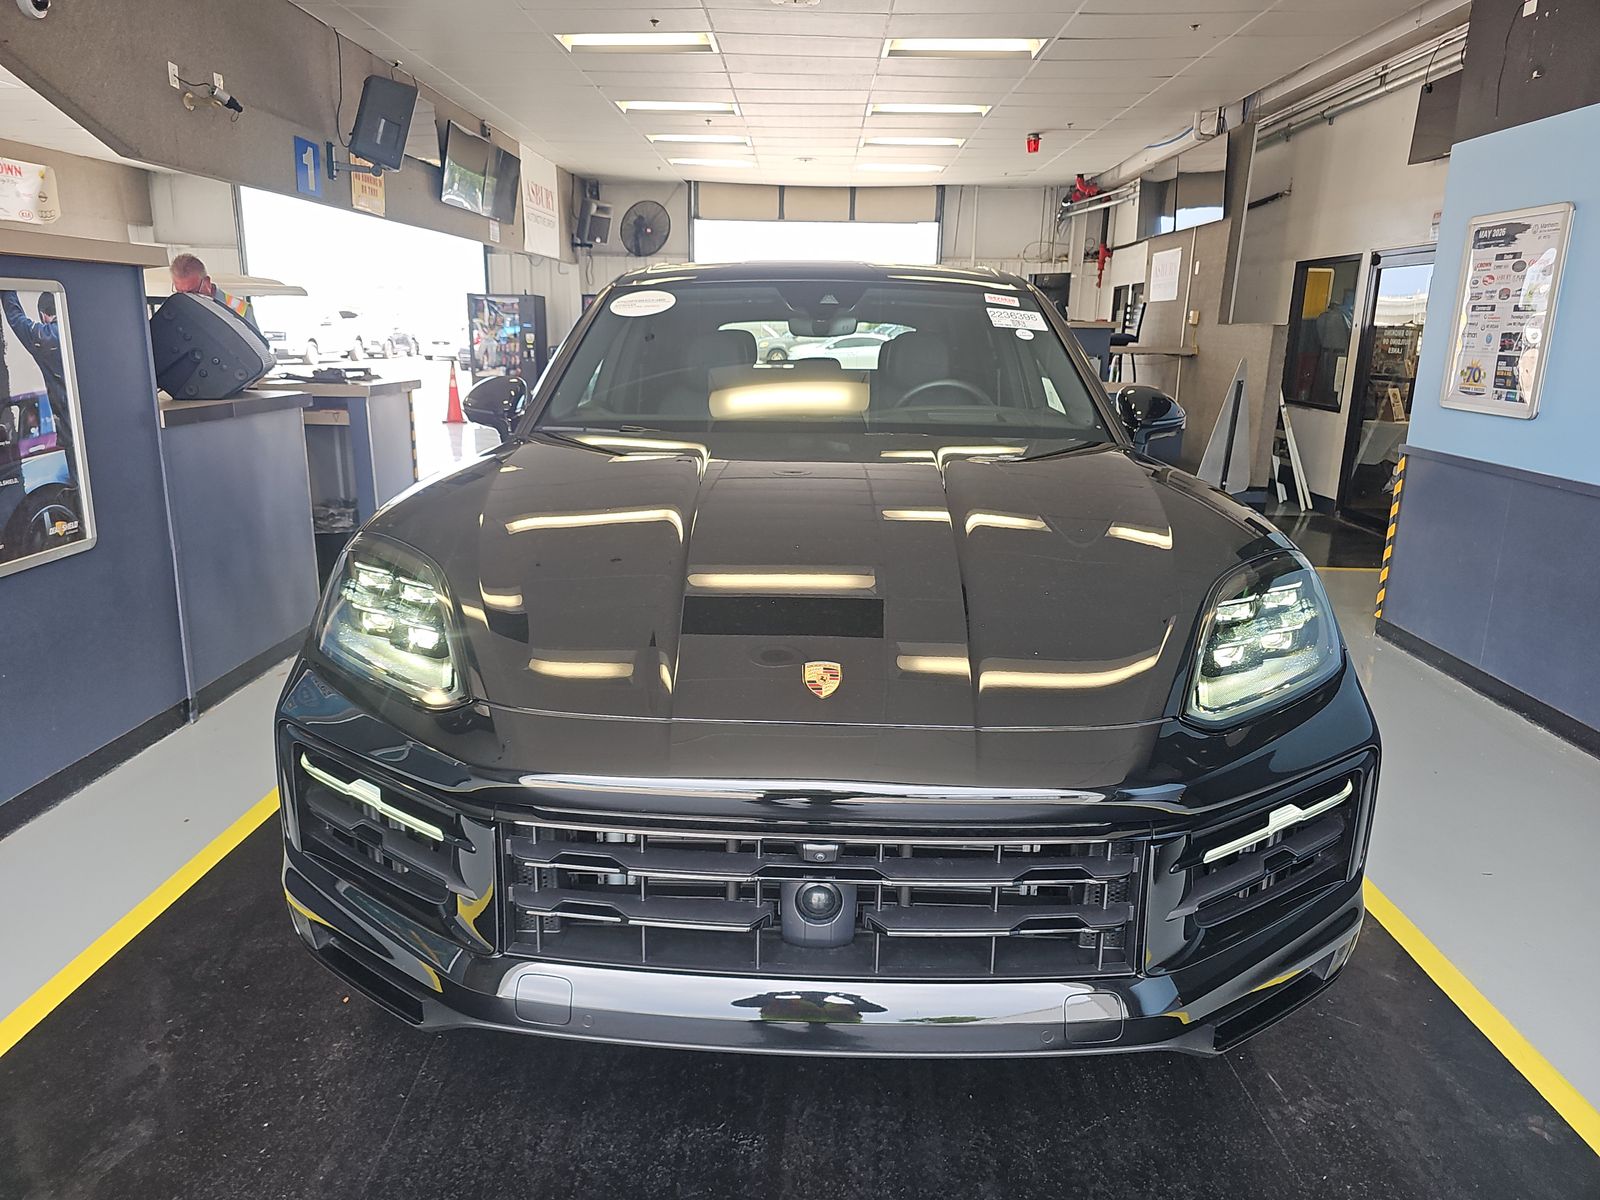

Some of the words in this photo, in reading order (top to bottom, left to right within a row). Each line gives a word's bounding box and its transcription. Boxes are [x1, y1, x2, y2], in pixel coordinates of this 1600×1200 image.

[303, 146, 316, 191] 1
[1478, 229, 1492, 239] MAY
[1466, 366, 1481, 383] 70
